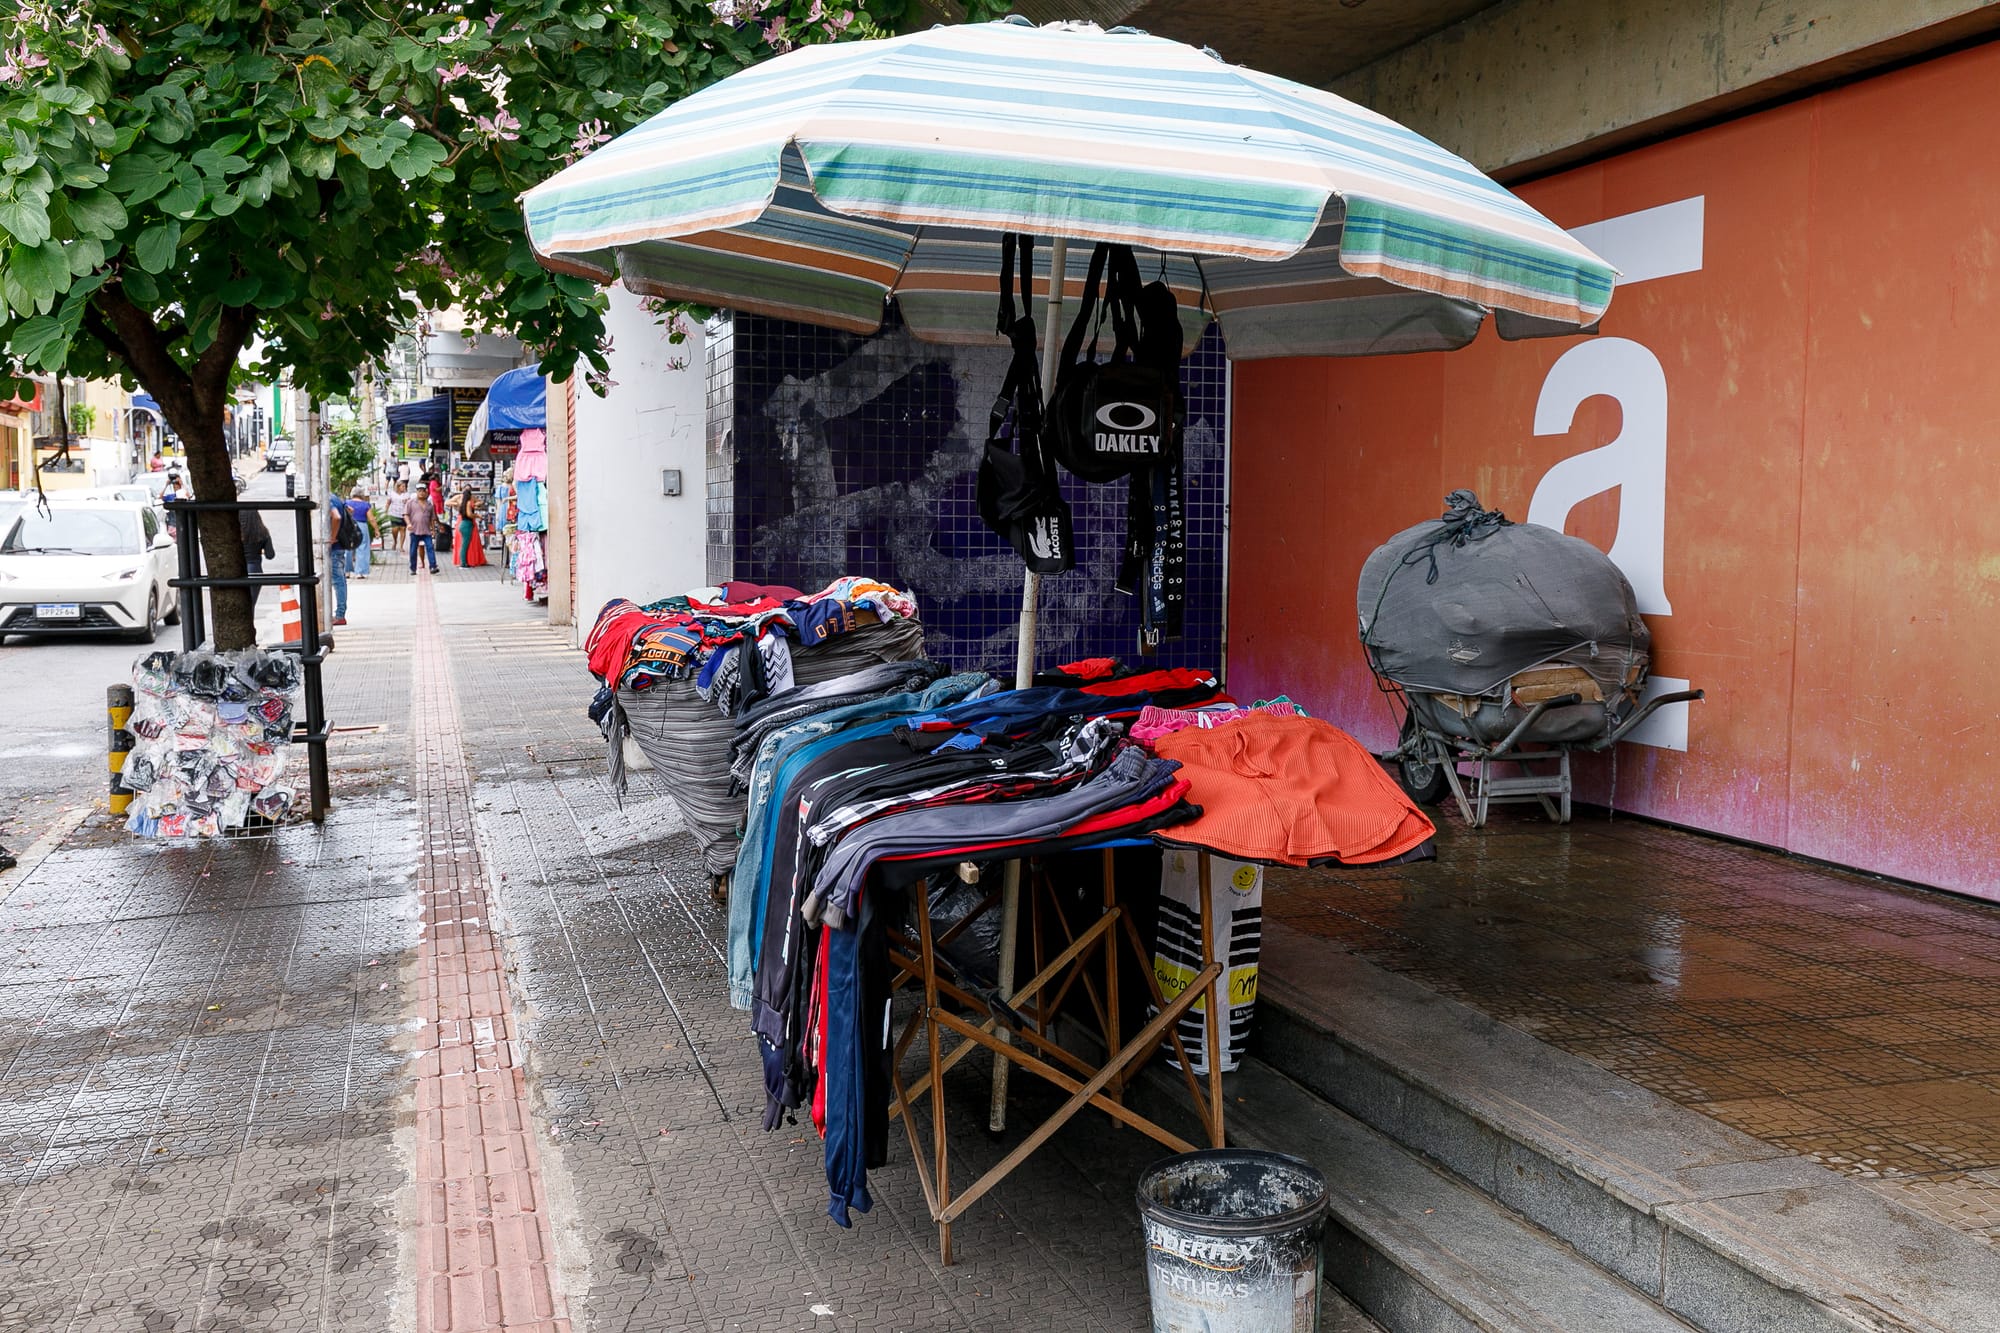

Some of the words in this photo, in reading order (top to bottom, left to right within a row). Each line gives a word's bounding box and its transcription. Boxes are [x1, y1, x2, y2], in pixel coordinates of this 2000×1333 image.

[1095, 433, 1160, 453] OAKLEY
[1050, 516, 1061, 559] LACOSTE
[1153, 1264, 1250, 1299] TEXTURAS
